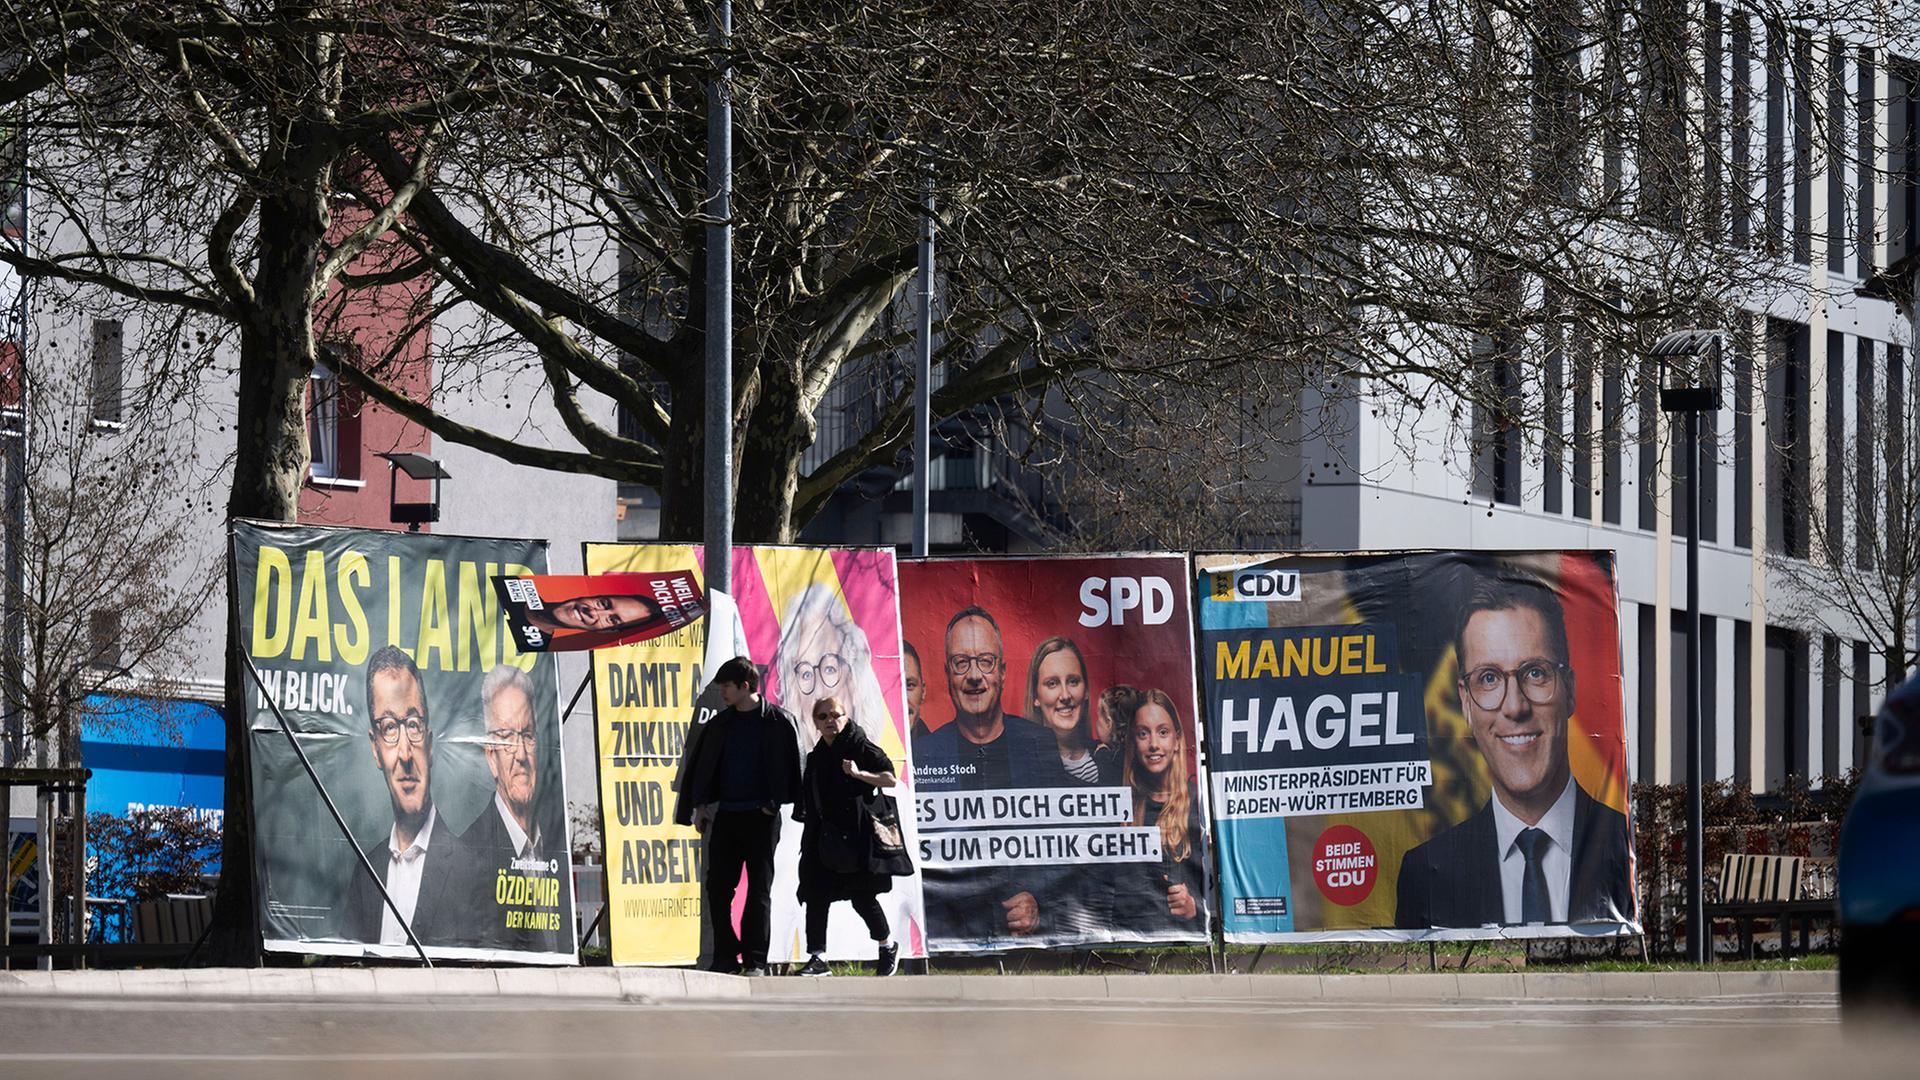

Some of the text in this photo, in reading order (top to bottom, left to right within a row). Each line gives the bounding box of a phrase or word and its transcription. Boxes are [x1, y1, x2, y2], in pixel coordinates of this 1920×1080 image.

[508, 580, 524, 600] WAHL
[522, 580, 541, 609] FLORIAN
[650, 580, 674, 605] DICH
[670, 577, 694, 602] WEIL
[1237, 574, 1296, 597] CDU
[252, 545, 371, 666] DAS
[1079, 576, 1174, 628] SPD
[522, 626, 544, 647] SPD
[1216, 634, 1387, 680] MANUEL
[257, 669, 353, 715] IM BLICK.
[608, 662, 681, 708] DAMIT
[1221, 691, 1415, 755] HAGEL
[914, 776, 957, 785] pitzenkandidat
[950, 764, 977, 775] Stoch
[1224, 762, 1427, 793] MINISTERPRÄSIDENT FÜR
[615, 781, 664, 827] UND
[944, 796, 986, 821] UM
[992, 795, 1050, 819] DICH
[1058, 793, 1129, 821] GEHT,
[1227, 788, 1418, 815] BADEN-WÜRTTEMBERG
[941, 838, 983, 862] UM
[989, 834, 1080, 860] POLITIK
[1087, 832, 1158, 857] GEHT.
[1325, 842, 1361, 857] BEIDE
[621, 839, 704, 885] ARBEIT
[1316, 855, 1375, 872] STIMMEN
[495, 868, 560, 907] ÖZDEMIR
[1327, 870, 1366, 888] CDU
[506, 911, 560, 931] DER KANN ES
